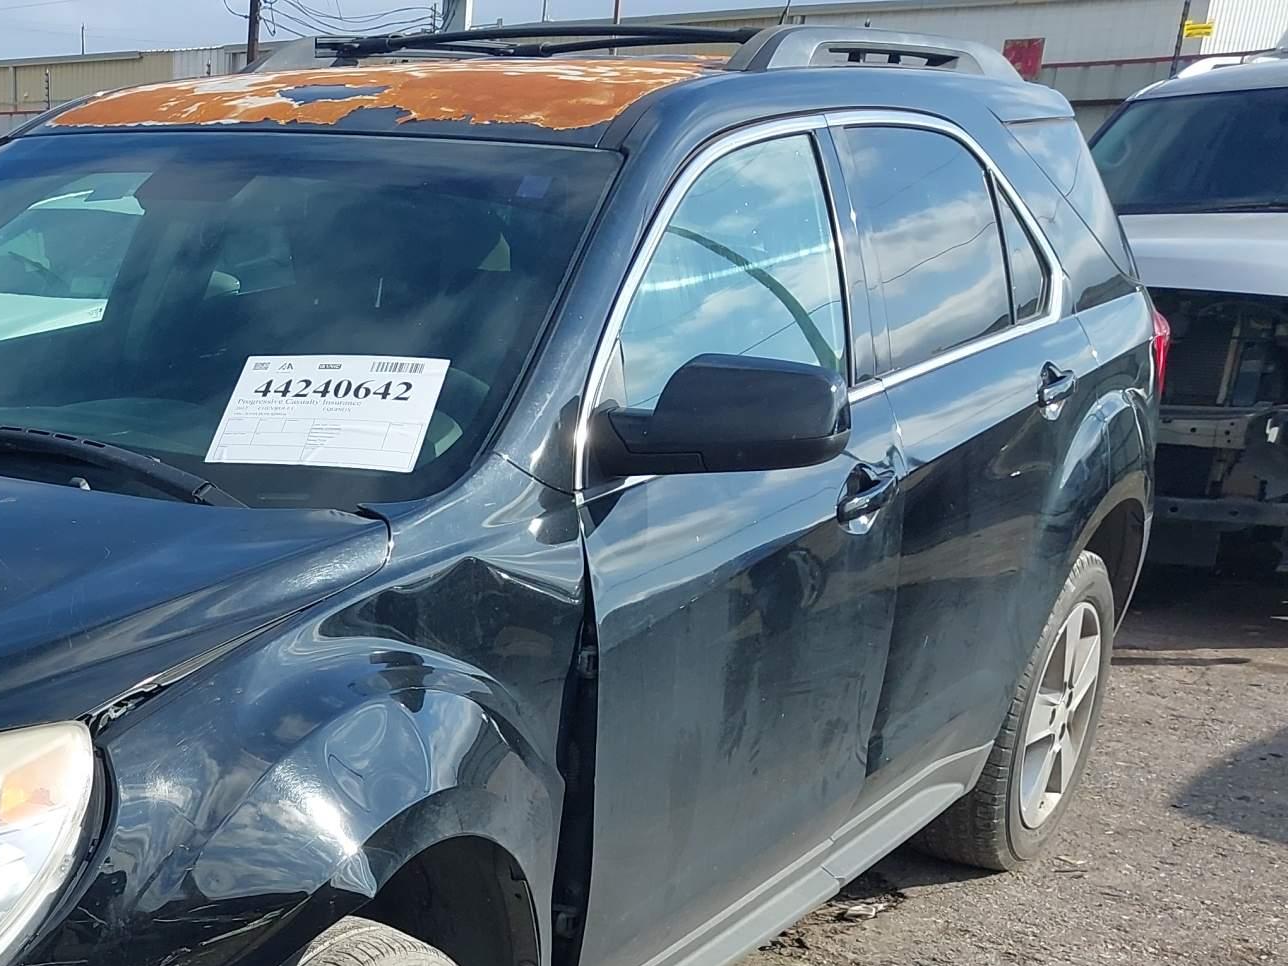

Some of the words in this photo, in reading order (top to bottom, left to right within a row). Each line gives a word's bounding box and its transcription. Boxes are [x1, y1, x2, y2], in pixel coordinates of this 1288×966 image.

[254, 378, 413, 401] 44240642
[237, 398, 284, 406] Progressive
[285, 398, 320, 407] Casualty
[322, 399, 362, 407] Insurance
